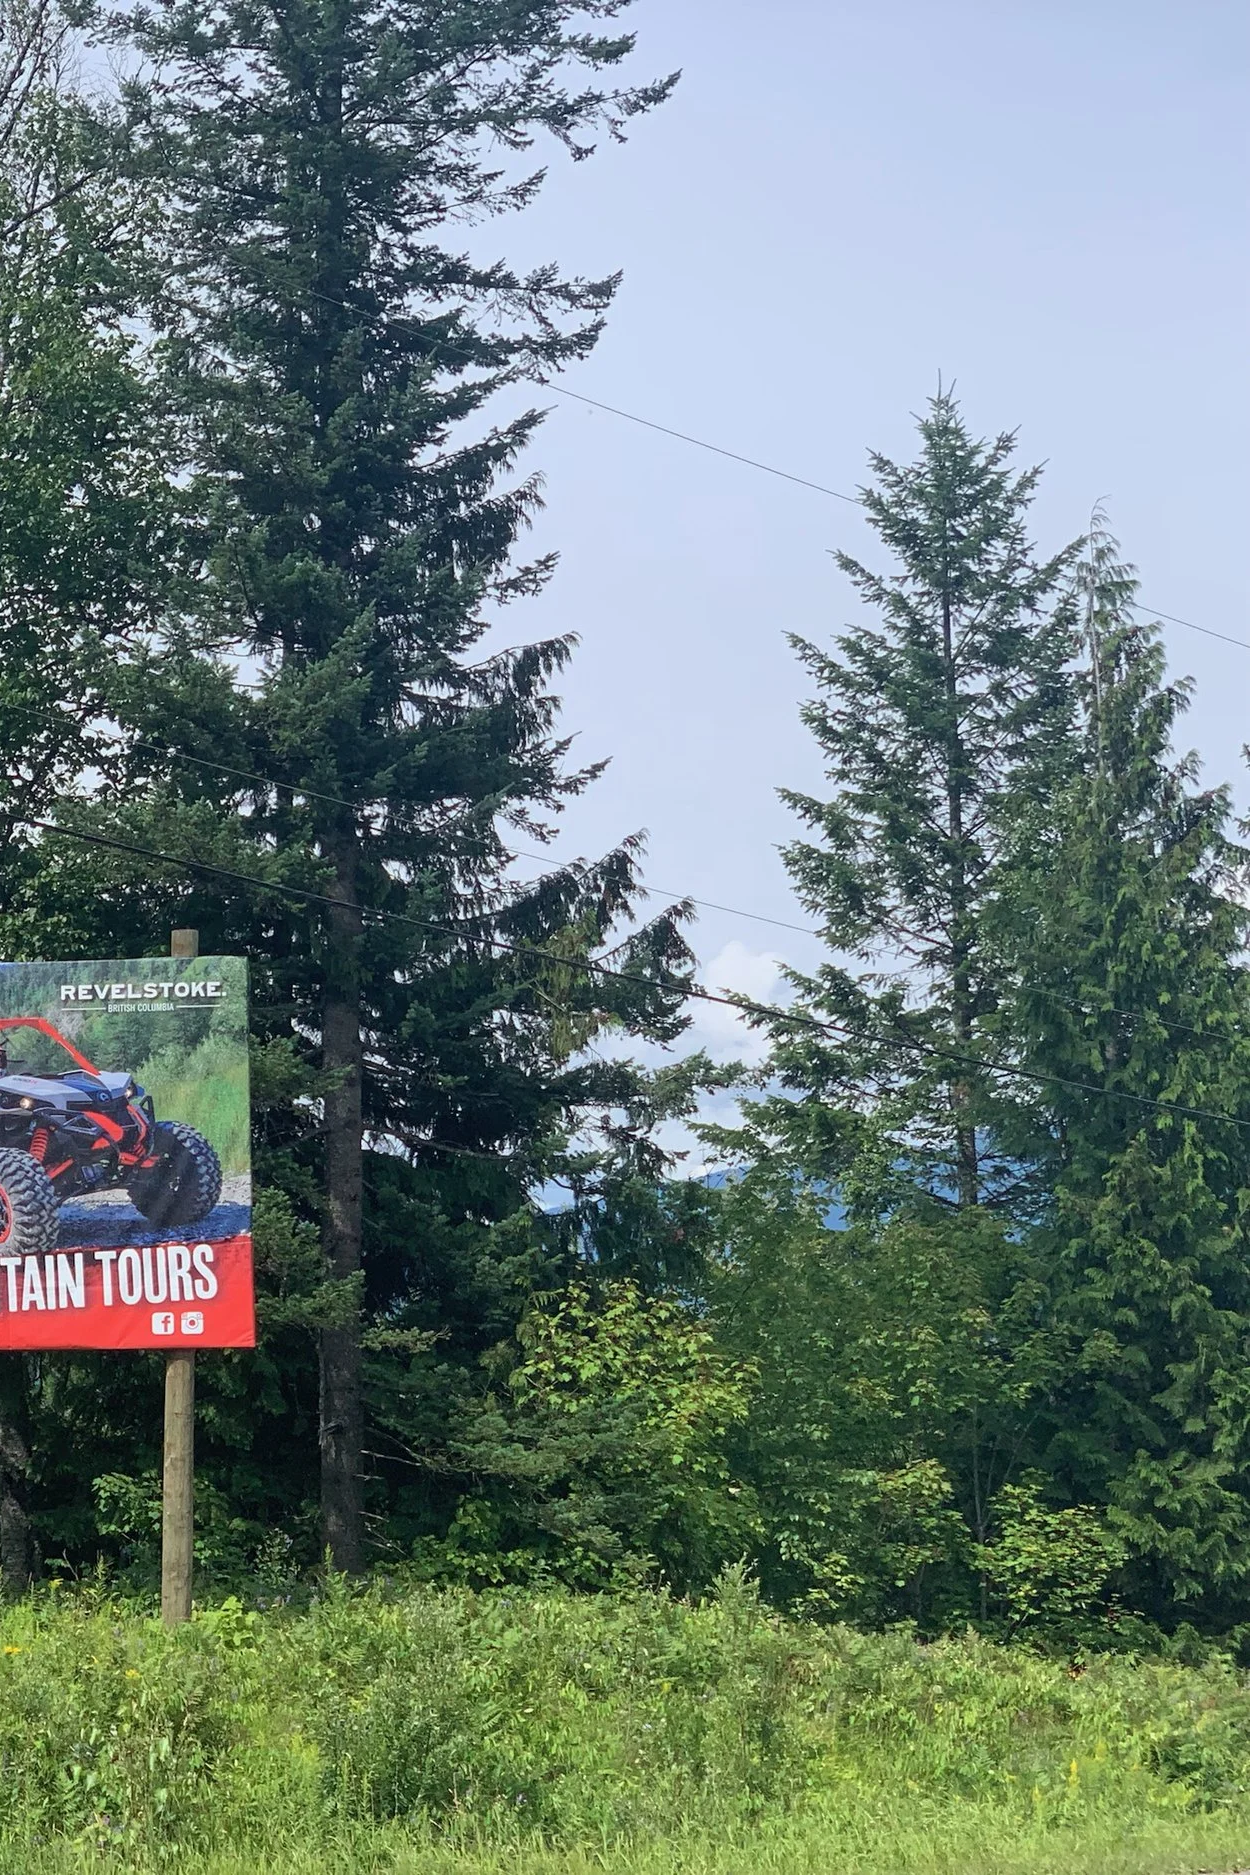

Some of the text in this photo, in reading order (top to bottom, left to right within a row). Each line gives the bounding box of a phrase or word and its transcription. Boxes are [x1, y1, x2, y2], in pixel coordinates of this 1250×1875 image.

[107, 1002, 175, 1013] BRITISH COLUMBIA
[94, 1245, 219, 1306] TOURS
